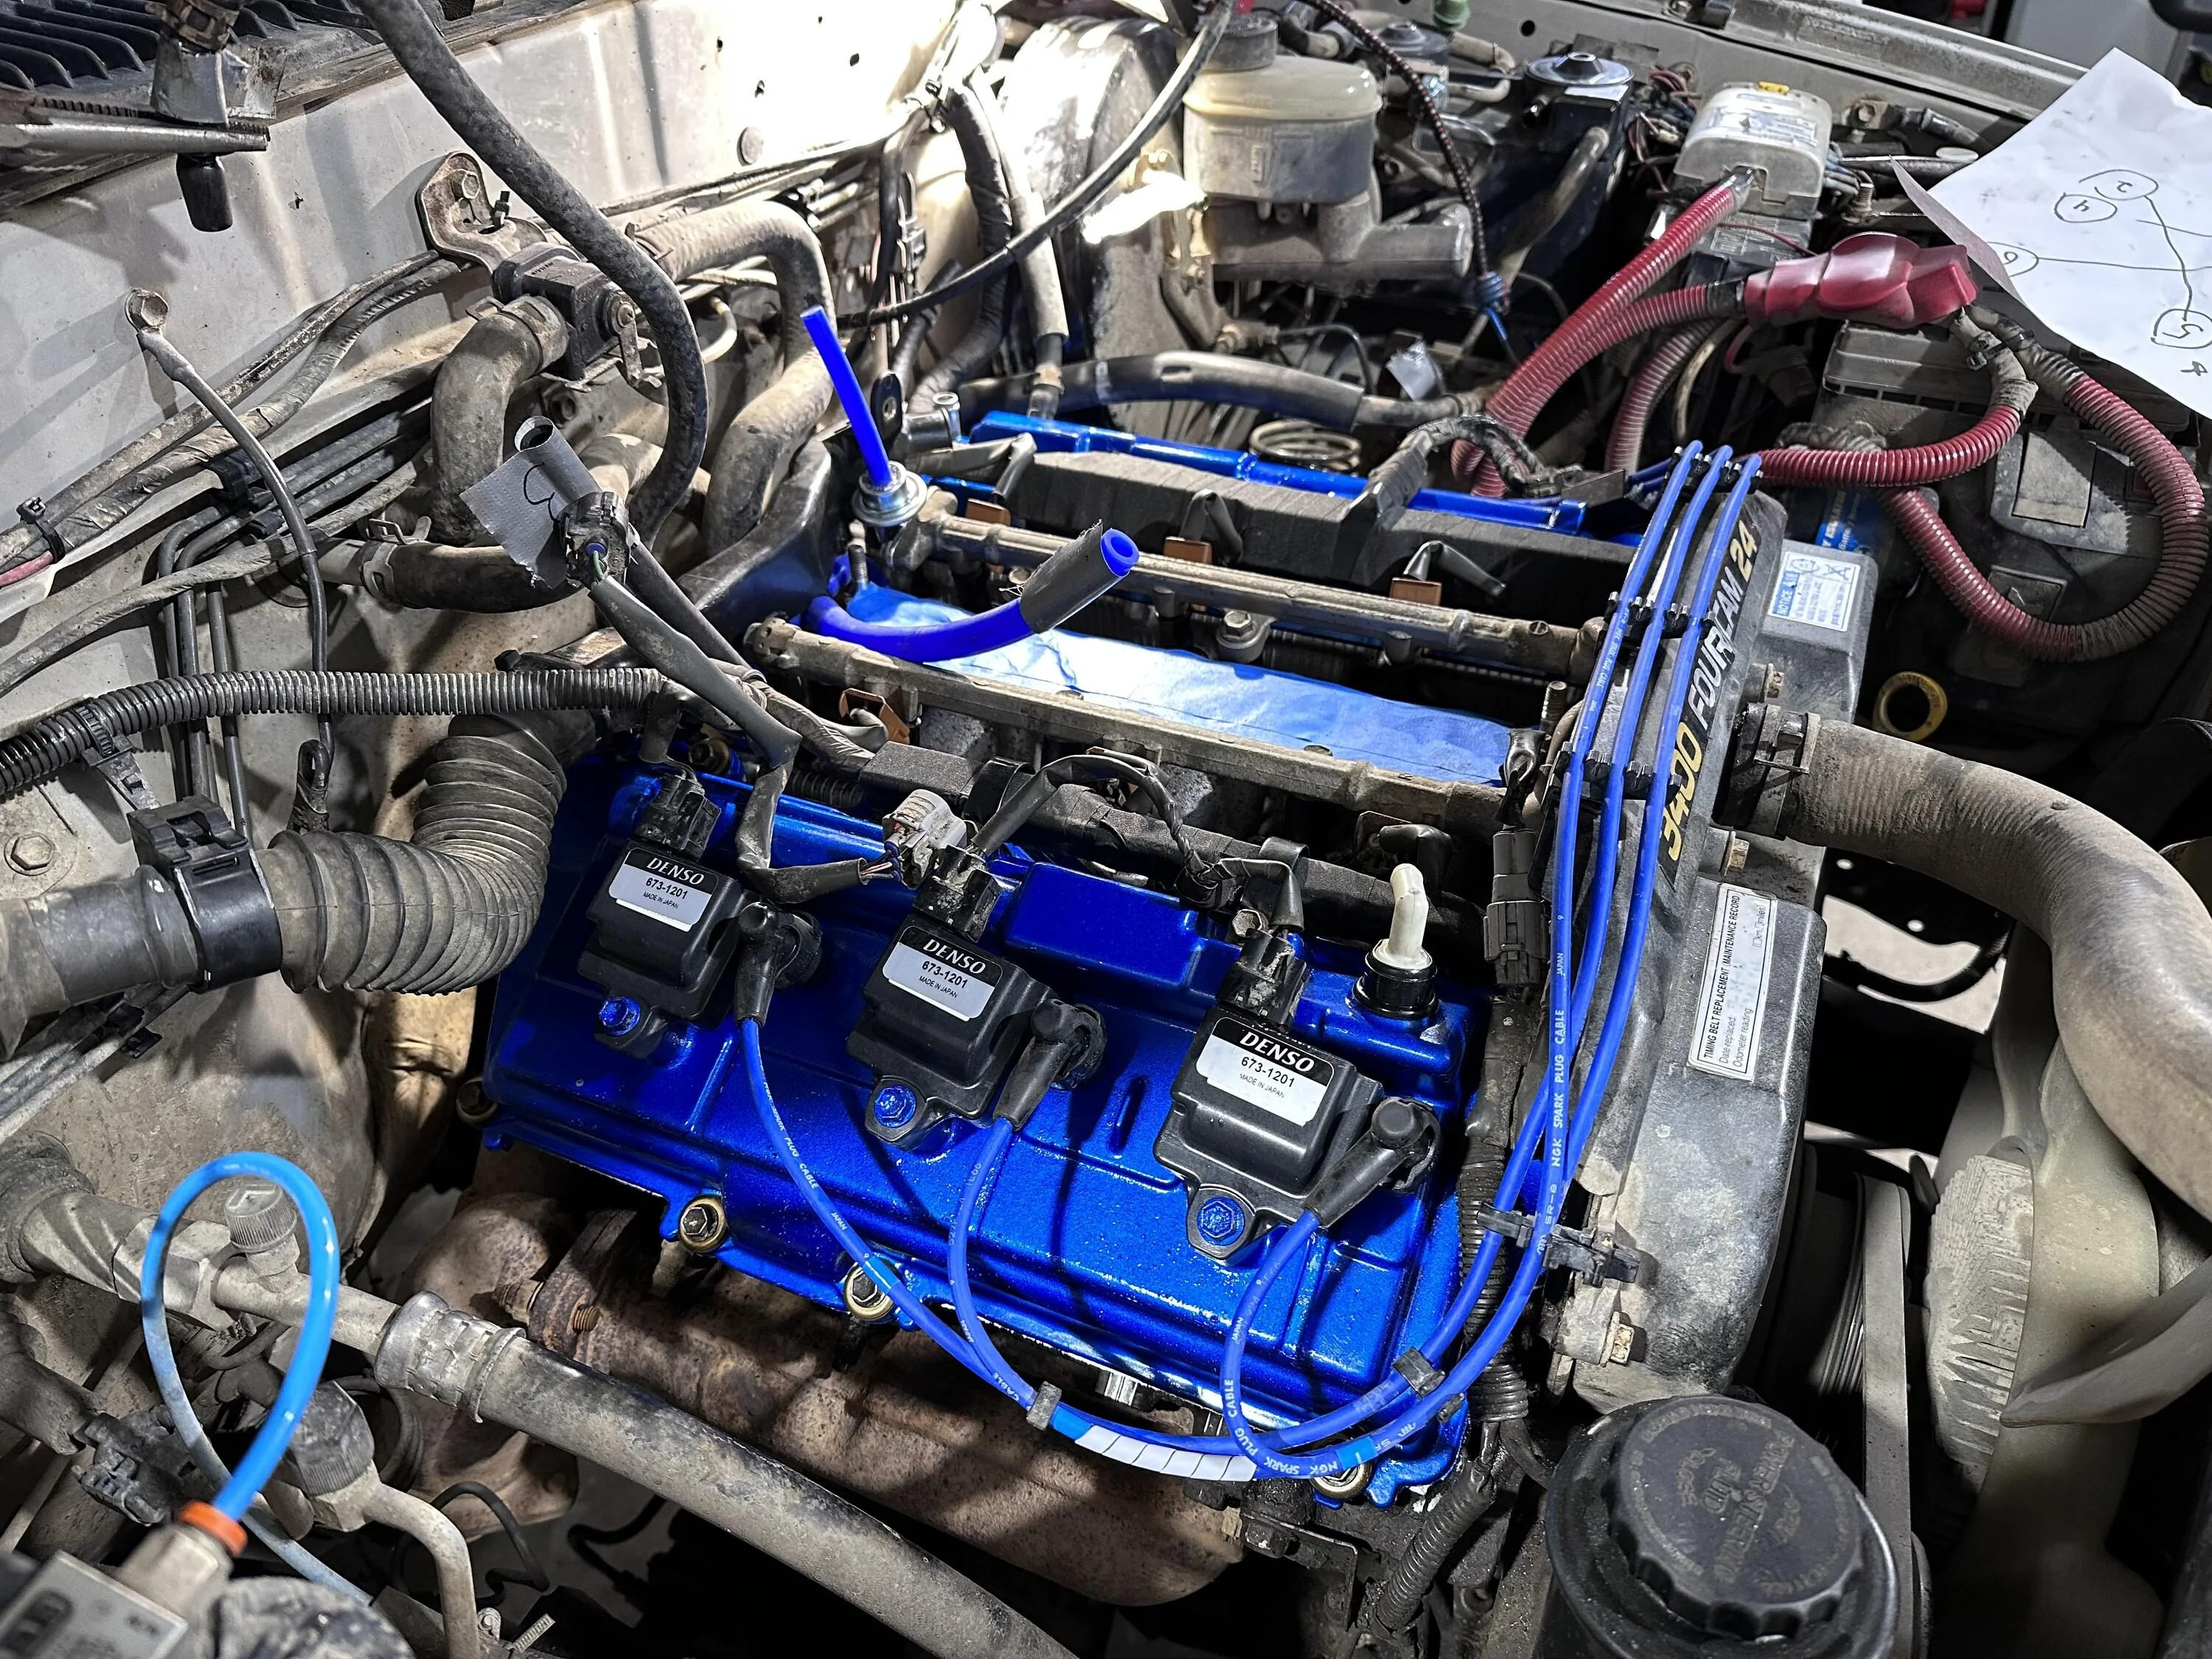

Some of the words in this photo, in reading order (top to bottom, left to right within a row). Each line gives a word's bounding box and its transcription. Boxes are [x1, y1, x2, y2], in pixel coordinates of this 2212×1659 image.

[1731, 519, 1758, 582] 24
[647, 857, 705, 886] DENSO
[643, 891, 658, 902] MADE
[663, 897, 680, 909] JAPAN
[646, 877, 689, 900] 673-1201
[923, 938, 987, 975] DENSO
[919, 975, 935, 987] MADE
[940, 984, 958, 998] JAPAN
[922, 960, 968, 989] 673-1201
[1714, 968, 1729, 1016] REPLACEMENT
[1555, 1009, 1565, 1045] CABLE
[1708, 1016, 1720, 1034] BELT
[1239, 1031, 1315, 1072] DENSO
[1704, 1034, 1717, 1059] TIMING
[1719, 1048, 1730, 1064] Date
[1733, 1033, 1747, 1068] Odometer
[1241, 1056, 1295, 1088] 673-1201
[1554, 1054, 1565, 1083] PLUG
[1239, 1073, 1258, 1086] MADE
[1264, 1082, 1284, 1099] JAPAN
[1554, 1093, 1564, 1128] SPARK
[1551, 1138, 1562, 1167] NGK
[785, 1136, 800, 1158] PLUG
[799, 1163, 820, 1189] CABLE
[831, 1211, 848, 1231] JAPAN
[1231, 1317, 1244, 1341] JAPAN
[993, 1371, 1020, 1402] CABLE
[1225, 1379, 1238, 1419] CABLE
[1234, 1427, 1259, 1457] PLUG
[1263, 1455, 1300, 1475] SPARK
[1309, 1460, 1339, 1475] NGK
